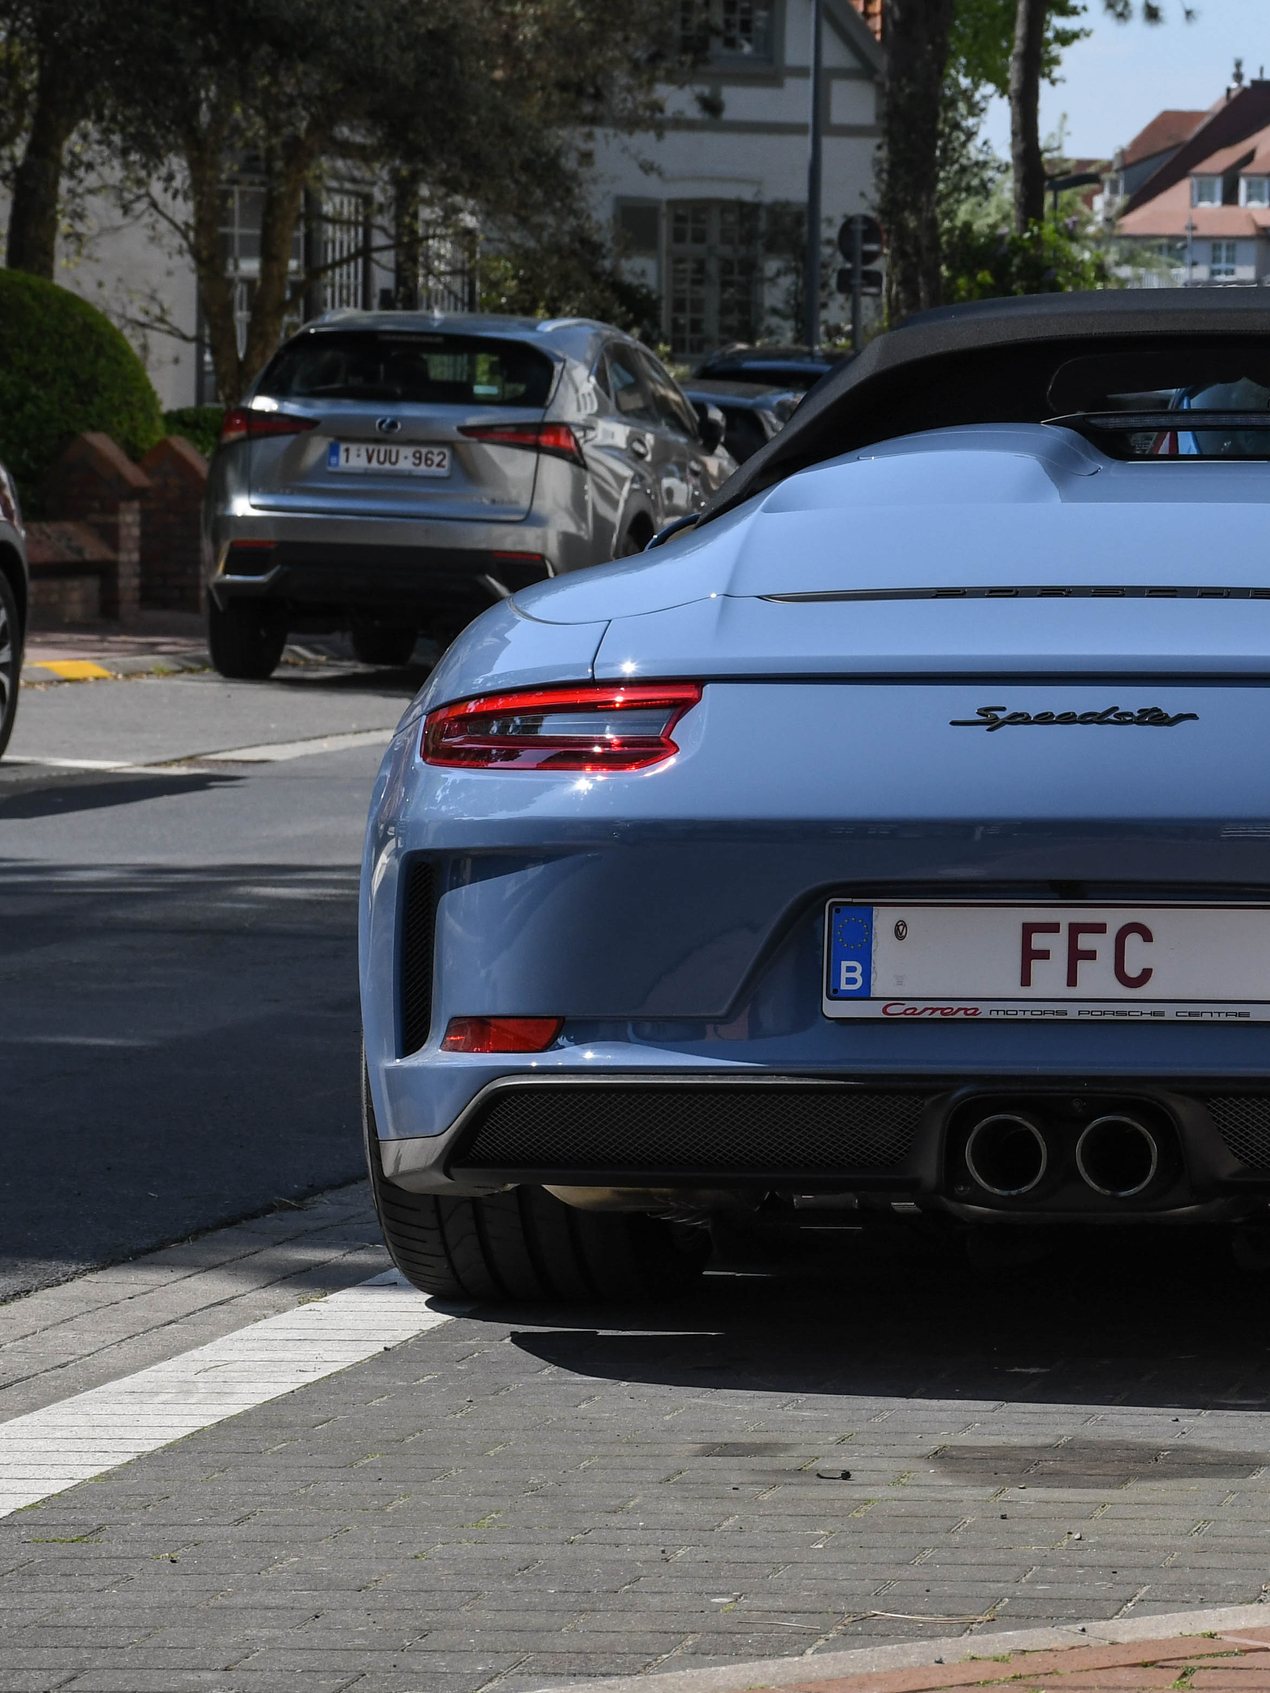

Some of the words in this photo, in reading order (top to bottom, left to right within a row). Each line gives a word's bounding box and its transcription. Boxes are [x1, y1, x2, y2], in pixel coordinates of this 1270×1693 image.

[949, 706, 1200, 732] Speedster
[1020, 922, 1154, 988] FFC
[839, 960, 863, 990] B
[881, 1002, 982, 1018] Carrera
[989, 1008, 1069, 1017] MOTORS
[1077, 1009, 1166, 1018] PORSCHE
[1175, 1009, 1251, 1018] CENTRE
